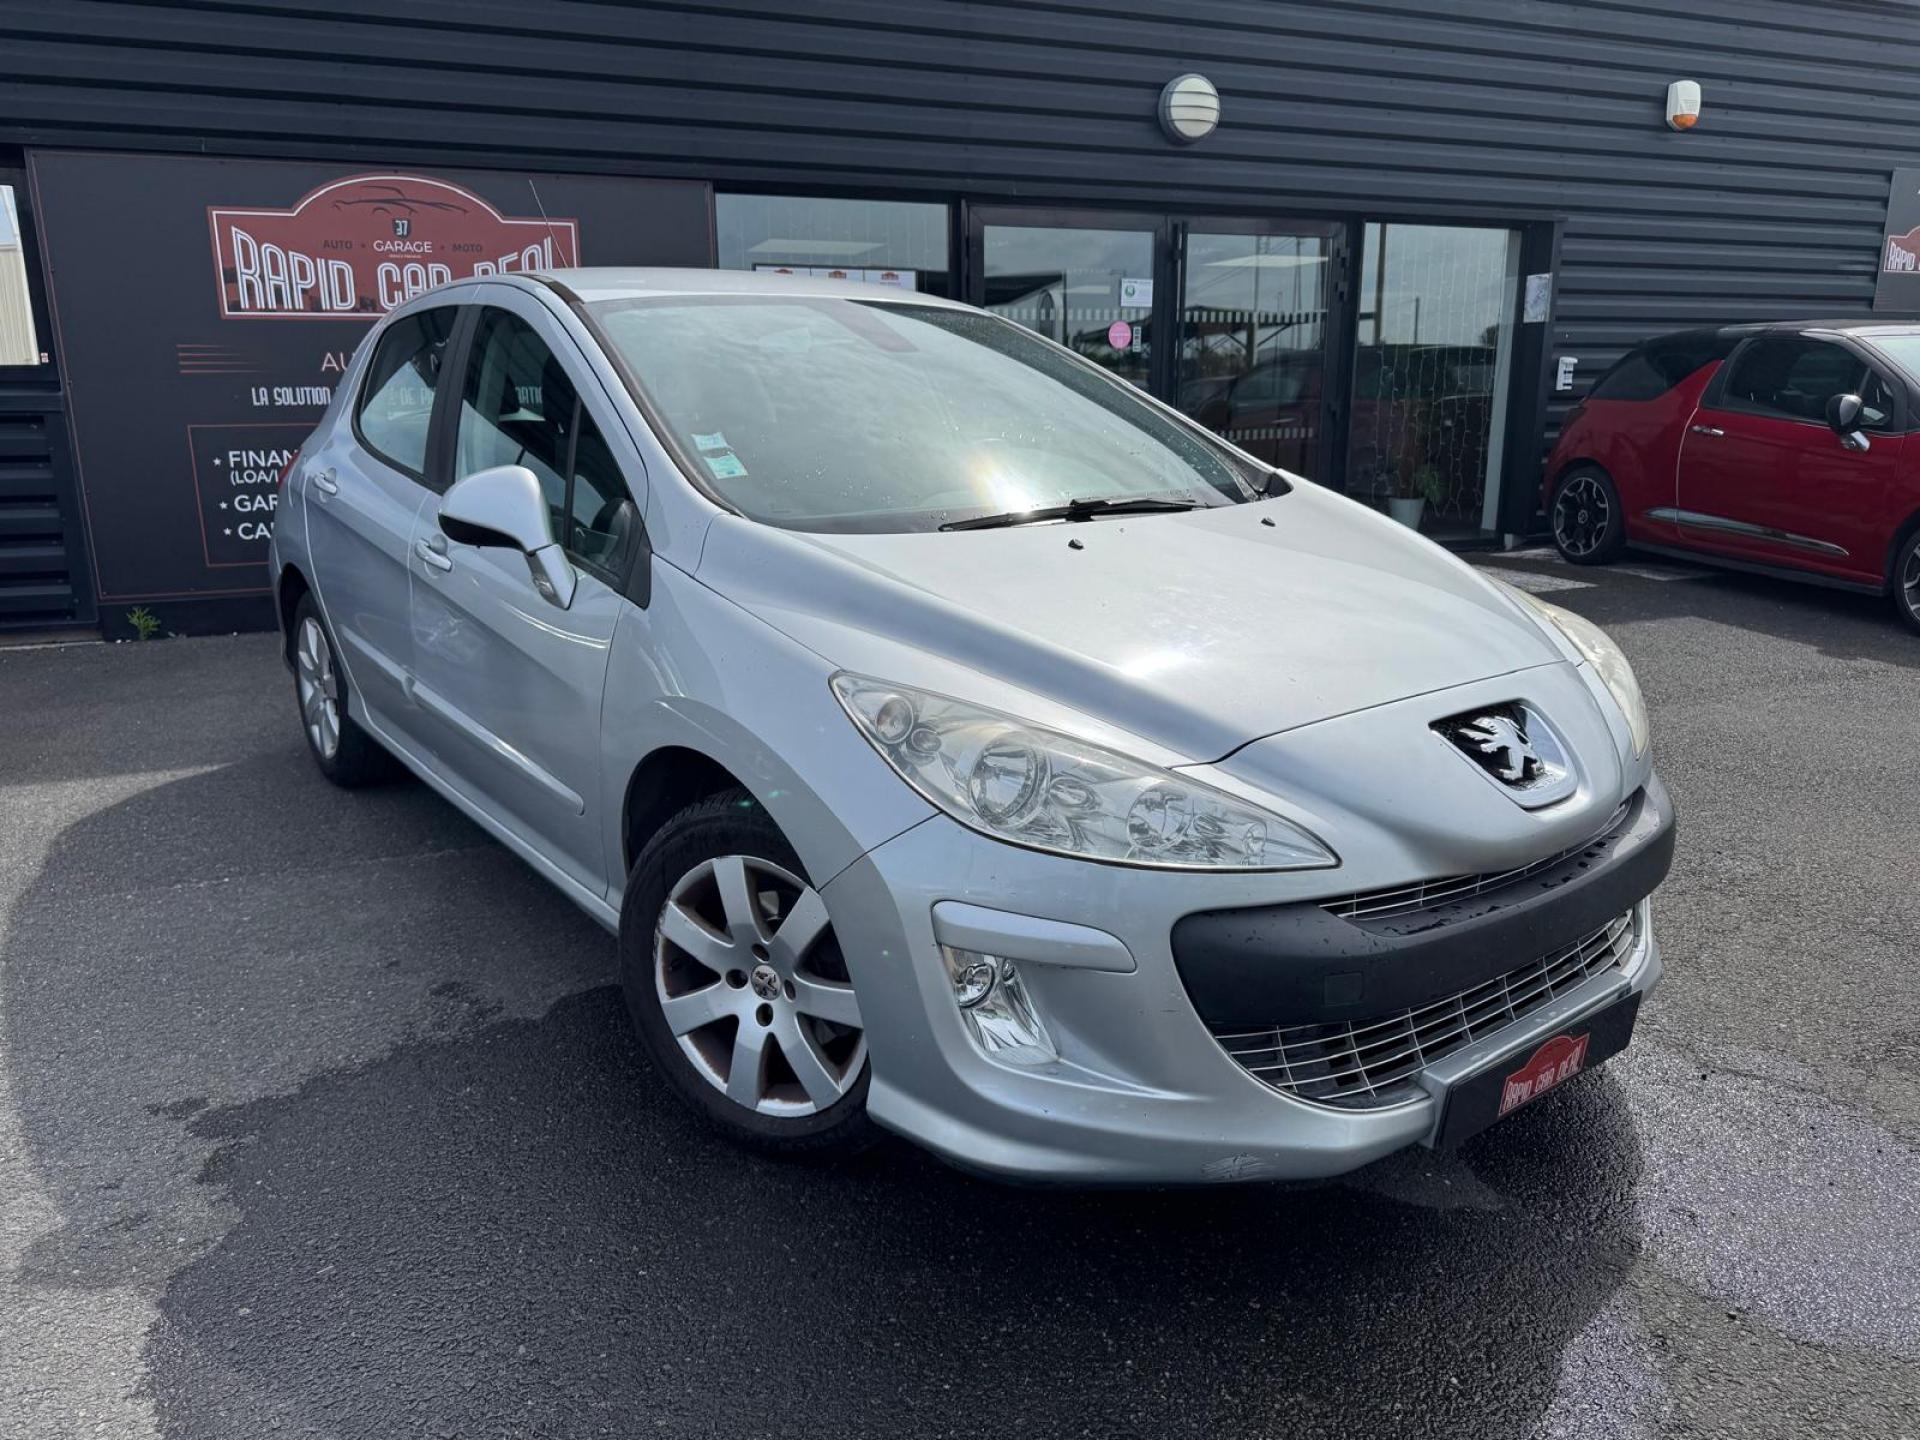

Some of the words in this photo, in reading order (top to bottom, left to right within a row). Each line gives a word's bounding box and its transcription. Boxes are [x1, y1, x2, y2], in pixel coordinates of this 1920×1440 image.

[323, 239, 353, 250] AUTO
[373, 240, 432, 253] GARAGE
[452, 243, 483, 254] MOTO
[1887, 241, 1916, 271] RAPID
[231, 226, 356, 310] RAPID
[251, 386, 269, 406] LA
[273, 386, 331, 406] SOLUTION
[228, 450, 298, 468] FINAN
